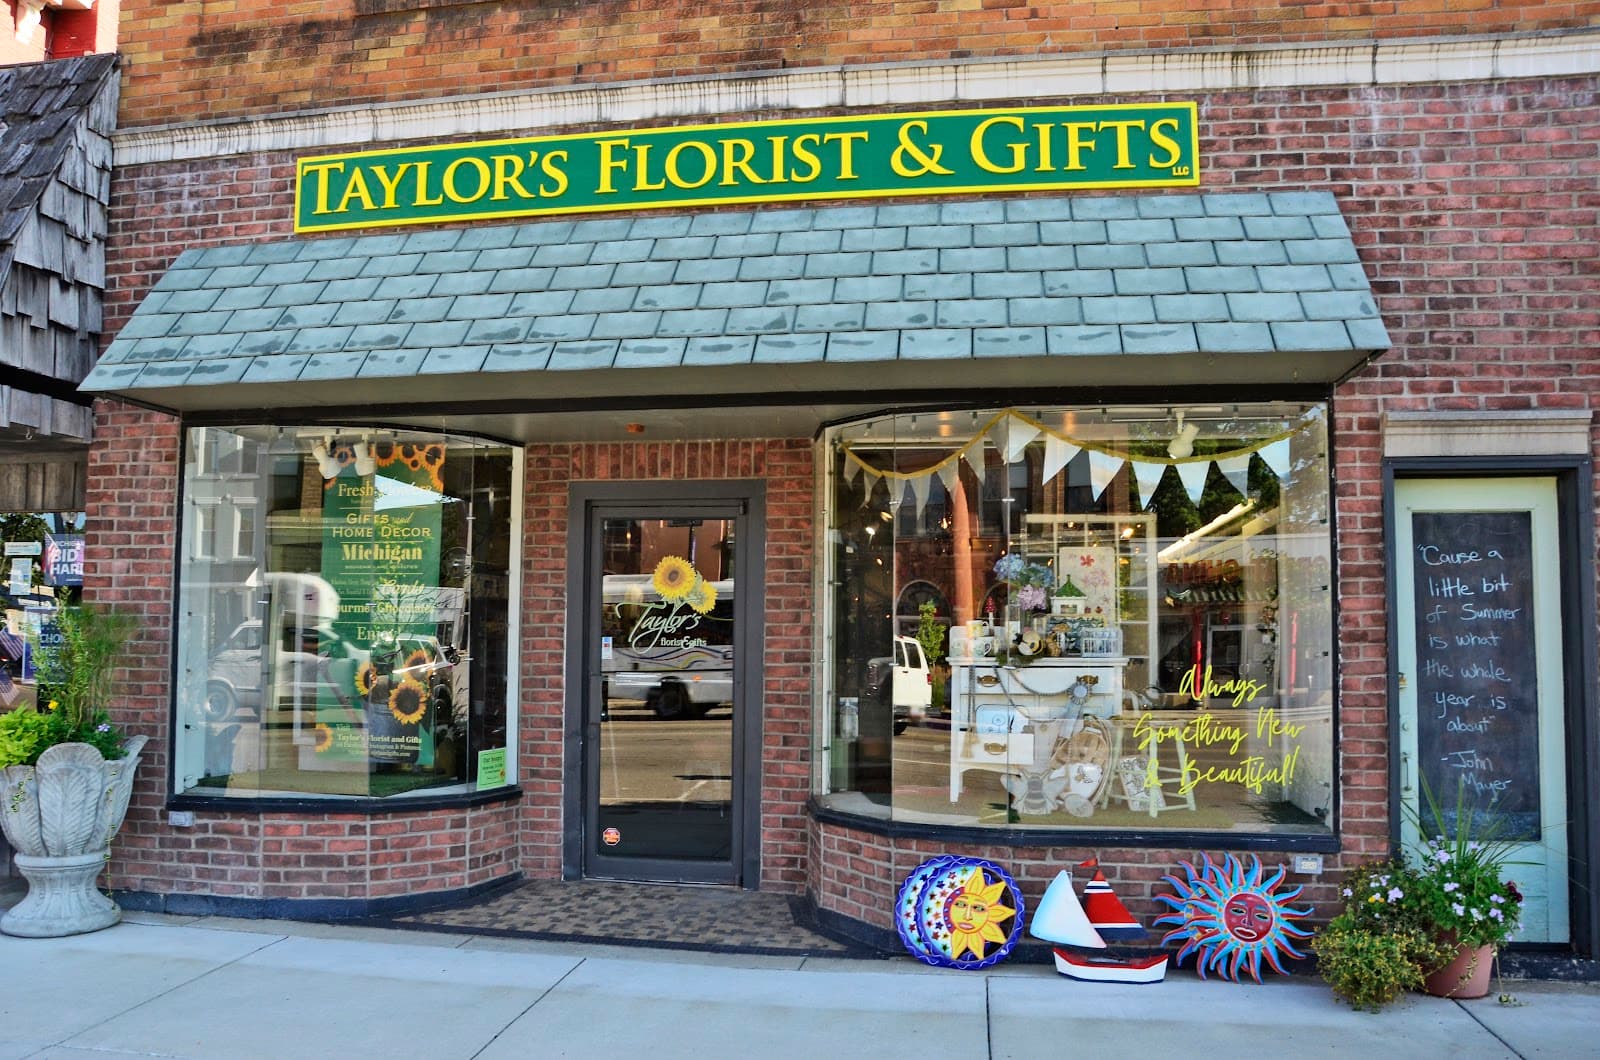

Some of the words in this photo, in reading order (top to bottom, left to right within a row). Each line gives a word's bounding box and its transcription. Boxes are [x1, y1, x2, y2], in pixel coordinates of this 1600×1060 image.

[303, 150, 569, 216] TAYLOR'S
[594, 130, 869, 195] FLORIST
[890, 120, 955, 178] &
[970, 116, 1182, 174] GIFTS
[1172, 166, 1190, 176] LLC
[337, 480, 374, 497] Fresh
[346, 512, 390, 525] GIFTS
[332, 527, 374, 538] HOME
[381, 526, 432, 538] DECOR
[342, 543, 423, 564] Michigan
[1487, 550, 1504, 561] a
[1428, 576, 1475, 598] little
[1482, 573, 1514, 593] bit
[1425, 604, 1448, 623] of
[1460, 603, 1522, 621] Summer
[615, 601, 702, 655] Taylor's
[1428, 633, 1449, 649] is
[1455, 631, 1502, 647] what
[1422, 659, 1454, 678] the
[1460, 660, 1512, 682] whole
[1179, 664, 1268, 708] Always
[1435, 691, 1475, 719] year
[1490, 693, 1506, 710] is
[1132, 712, 1249, 755] Something
[1256, 705, 1307, 748] New
[1144, 758, 1163, 788] &
[1177, 745, 1301, 795] Beautiful!
